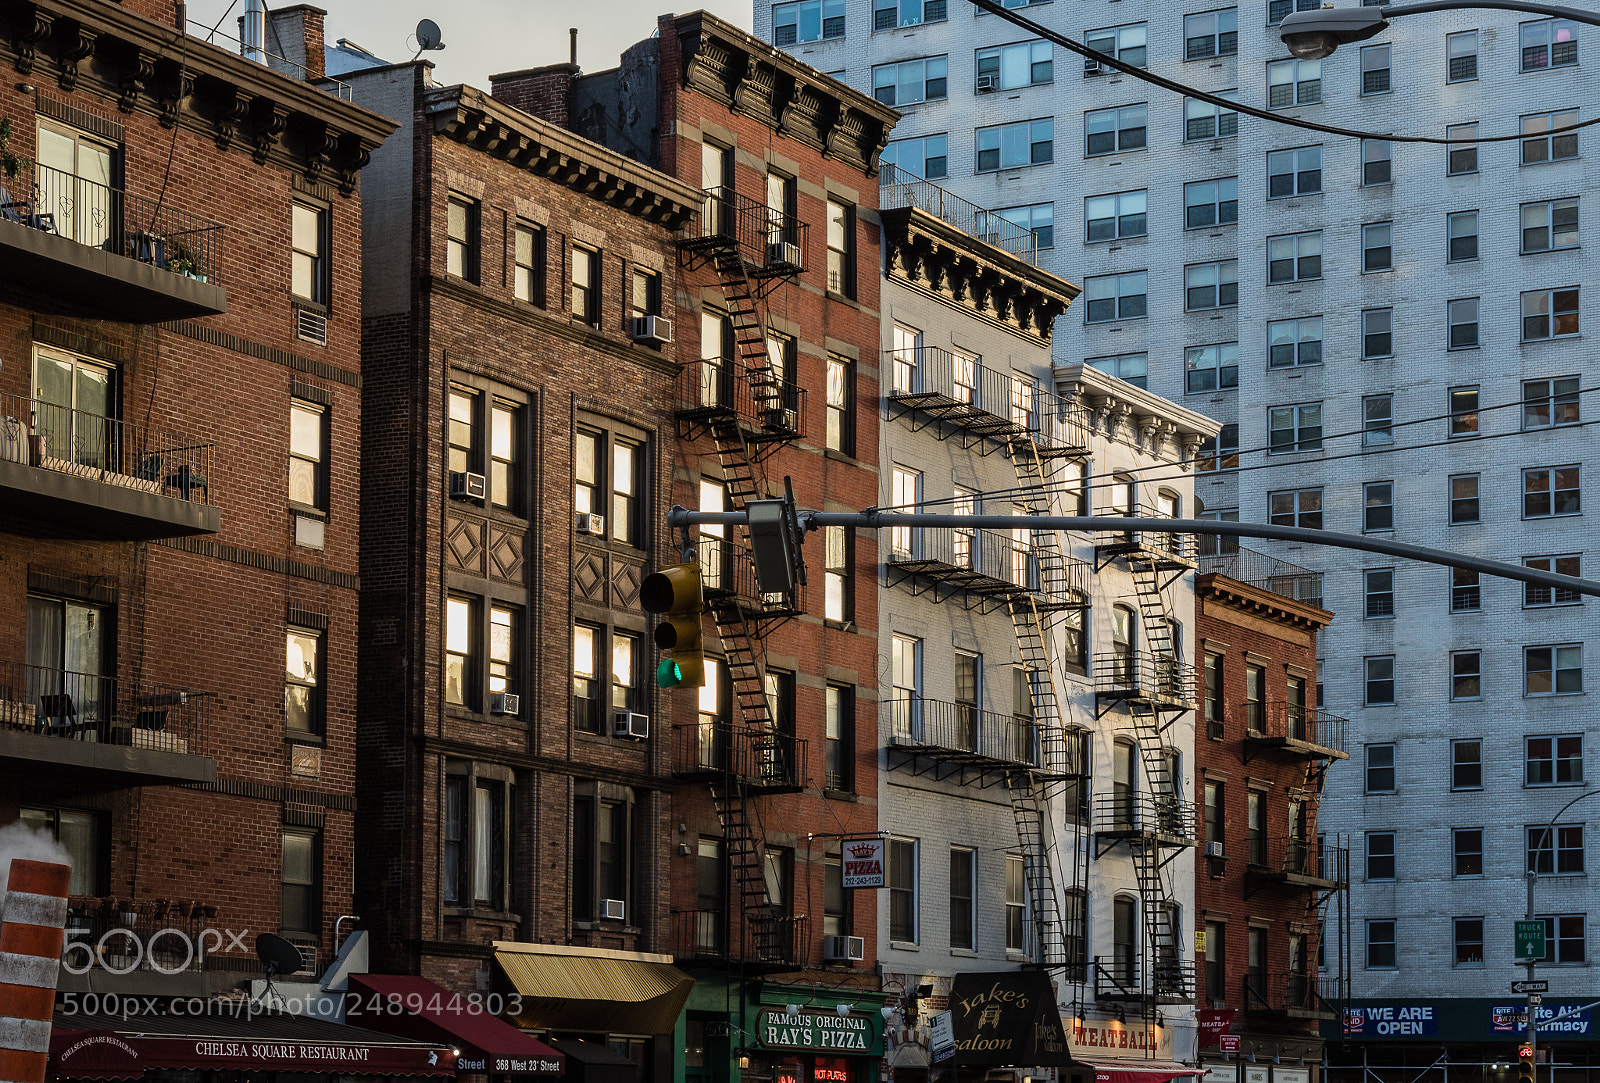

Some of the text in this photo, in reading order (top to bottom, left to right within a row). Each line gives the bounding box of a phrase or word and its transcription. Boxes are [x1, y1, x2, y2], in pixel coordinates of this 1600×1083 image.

[844, 860, 882, 876] PIZZA
[1518, 932, 1542, 940] ROUTE
[960, 982, 1030, 1018] Jake's
[1367, 1007, 1432, 1020] WE ARE
[1524, 1006, 1581, 1018] ite Aid
[767, 1012, 866, 1030] FAMOUS ORIGINAL
[1377, 1022, 1423, 1034] OPEN
[1518, 1021, 1588, 1034] Parmacy
[767, 1026, 866, 1049] RAY'S PIZZA
[953, 1034, 1013, 1050] saloon
[1075, 1027, 1158, 1050] MEATBALL
[61, 1041, 84, 1061] CHELSEA
[84, 1036, 106, 1046] SQUARE
[106, 1036, 138, 1059] RESTAURANT
[196, 1042, 370, 1060] CHELSEA SQUARE RESTAURANT
[458, 1058, 485, 1070] Street
[496, 1060, 508, 1071] 368
[511, 1060, 526, 1071] West
[540, 1060, 560, 1072] Street
